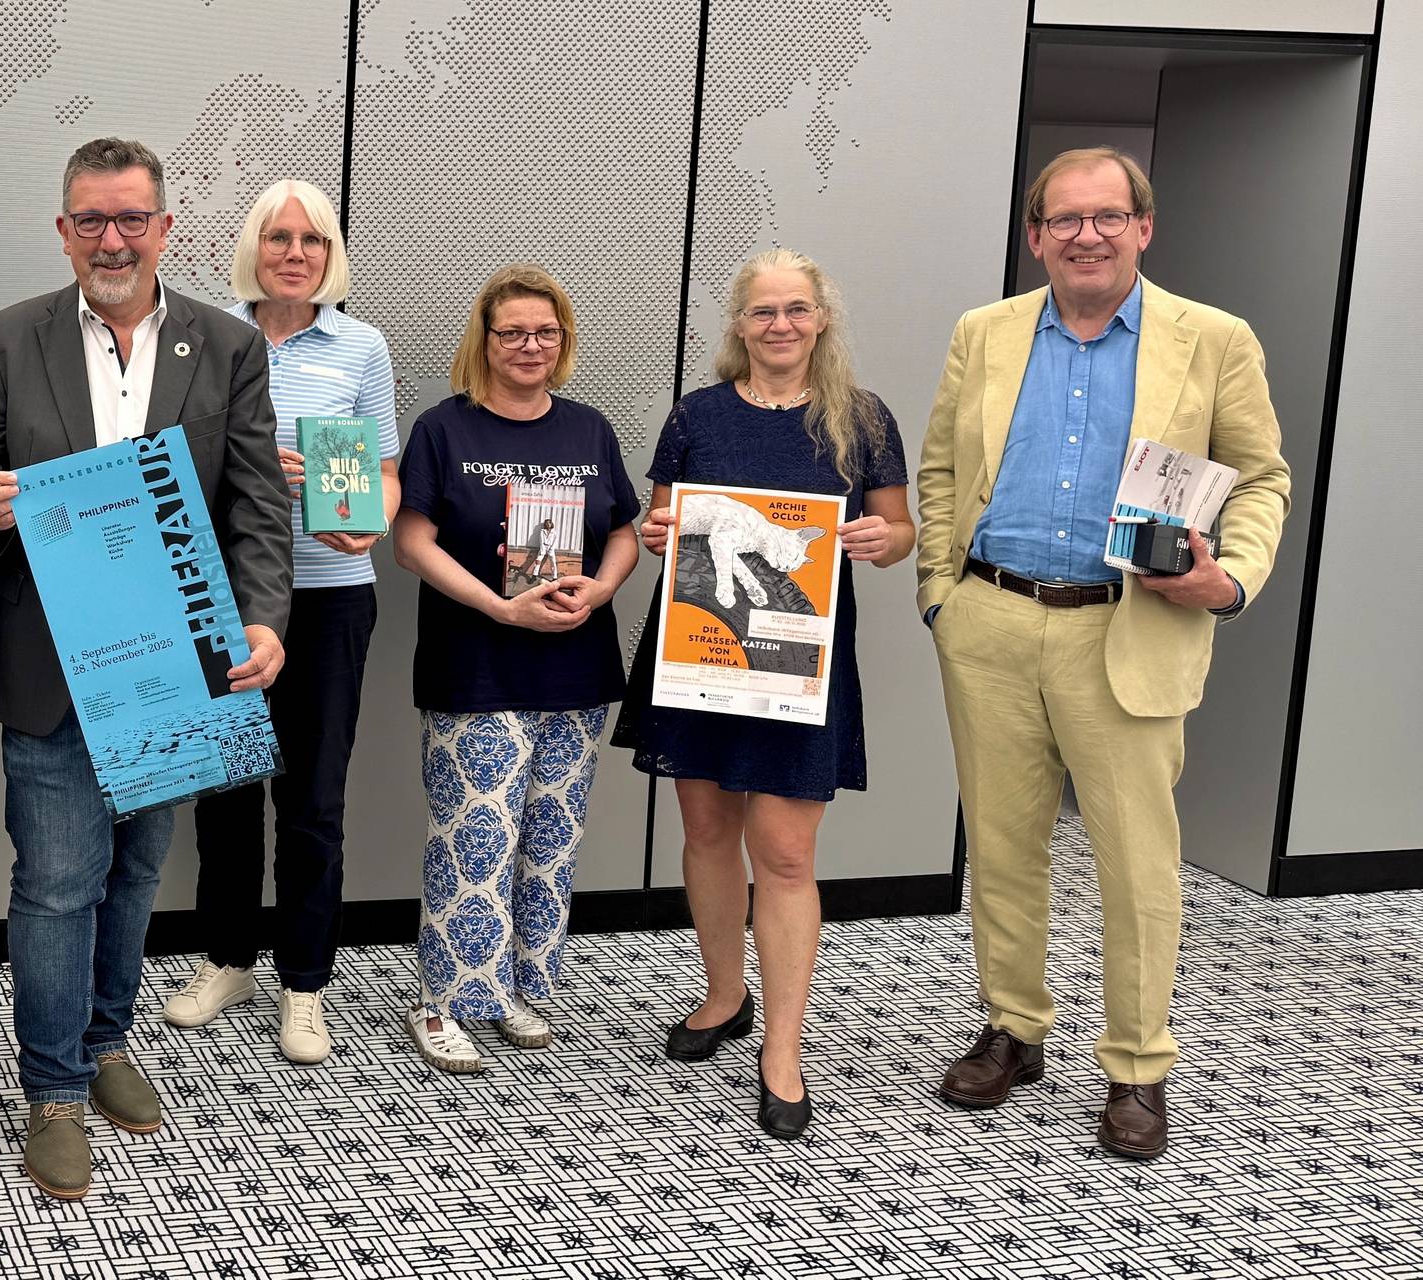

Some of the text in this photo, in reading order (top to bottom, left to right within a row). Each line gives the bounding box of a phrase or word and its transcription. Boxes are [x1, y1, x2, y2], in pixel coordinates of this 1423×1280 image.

[329, 457, 360, 474] WILD
[1134, 446, 1150, 472] EJOT
[40, 453, 144, 488] BERLEBURGER
[462, 462, 599, 477] FORGET FLOWERS
[320, 474, 370, 493] SONG
[531, 471, 585, 487] Books
[78, 496, 140, 520] PHILIPPINEN
[768, 501, 808, 512] ARCHIE
[771, 512, 807, 522] OCLOS
[702, 625, 720, 635] DIE
[69, 631, 157, 664] 4. September bis
[688, 634, 781, 651] STRASSEN KATZEN
[708, 646, 730, 656] VON
[73, 638, 174, 676] 28. November 2025
[699, 656, 739, 667] MANILA
